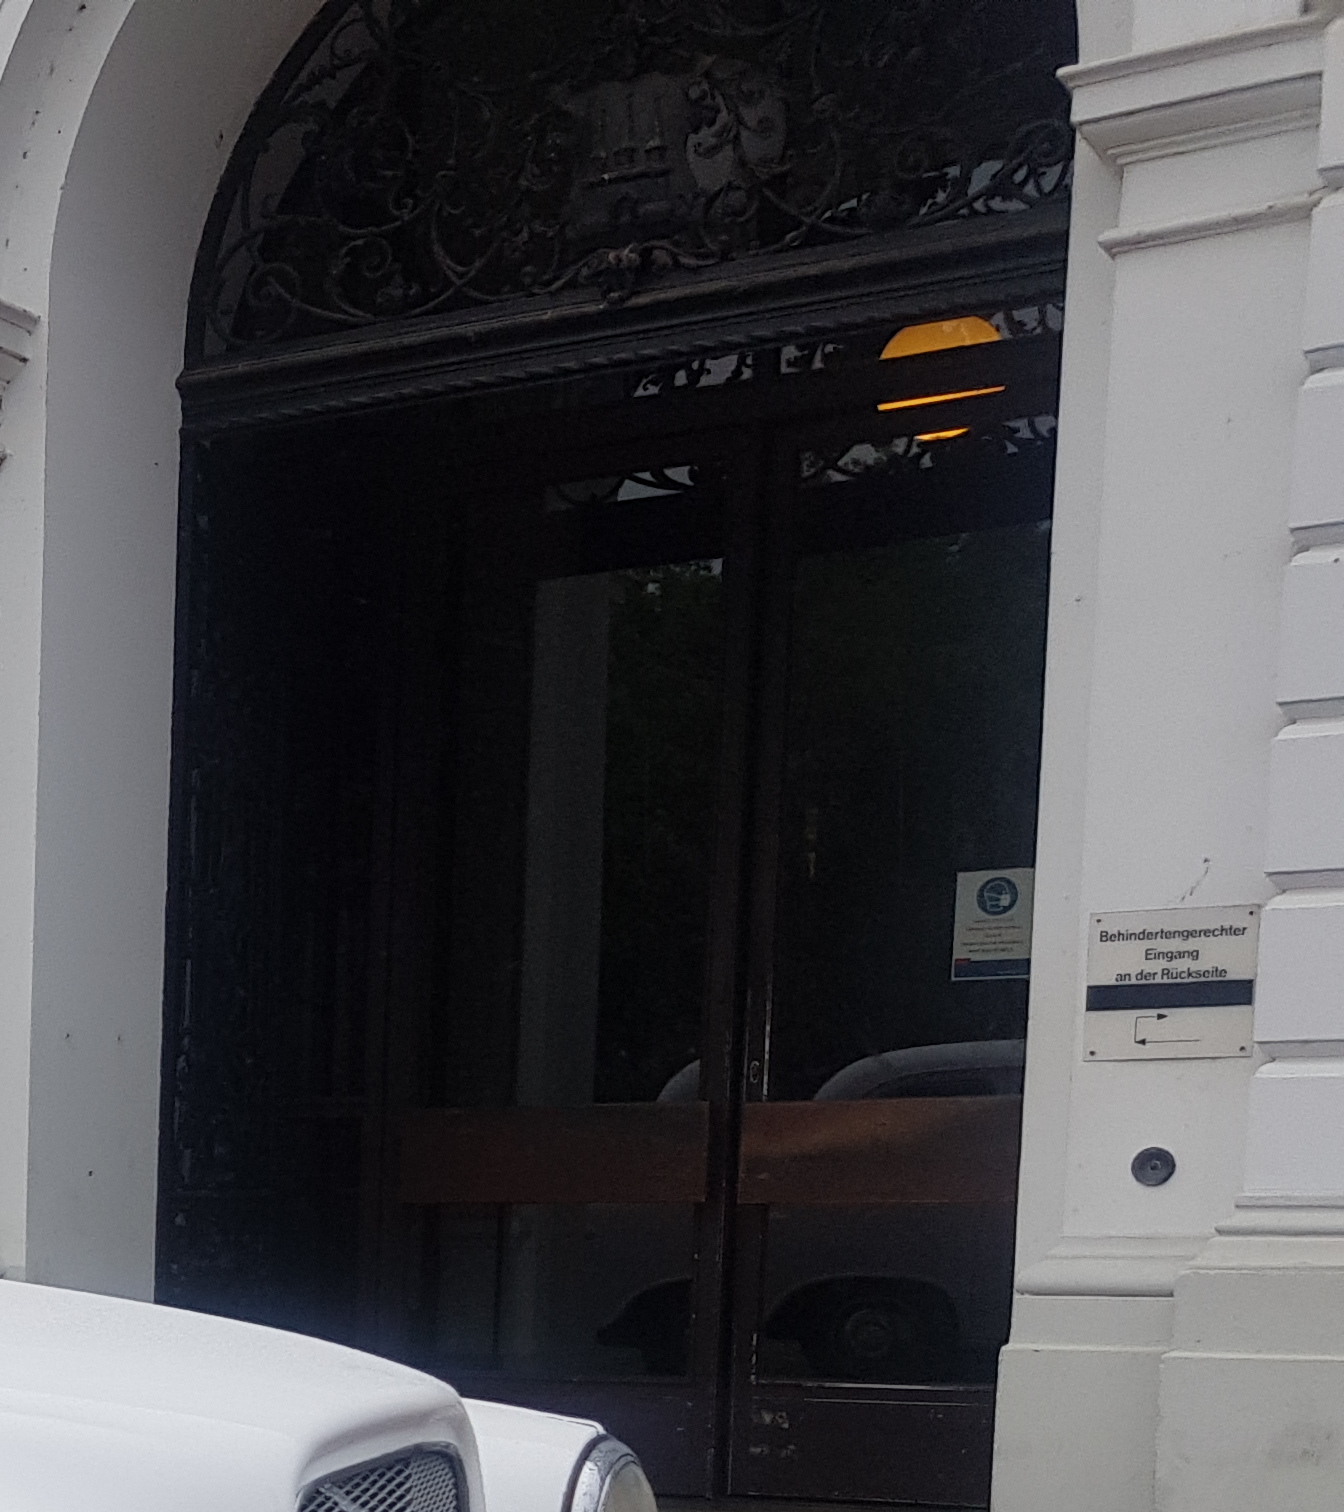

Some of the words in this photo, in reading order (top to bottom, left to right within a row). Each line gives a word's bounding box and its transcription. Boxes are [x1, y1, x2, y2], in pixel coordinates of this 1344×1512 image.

[1099, 925, 1248, 943] Behindertengerechter
[1144, 948, 1200, 962] Eingang
[1115, 973, 1132, 982] an
[1135, 969, 1158, 981] der
[1161, 966, 1228, 980] Rückseite
